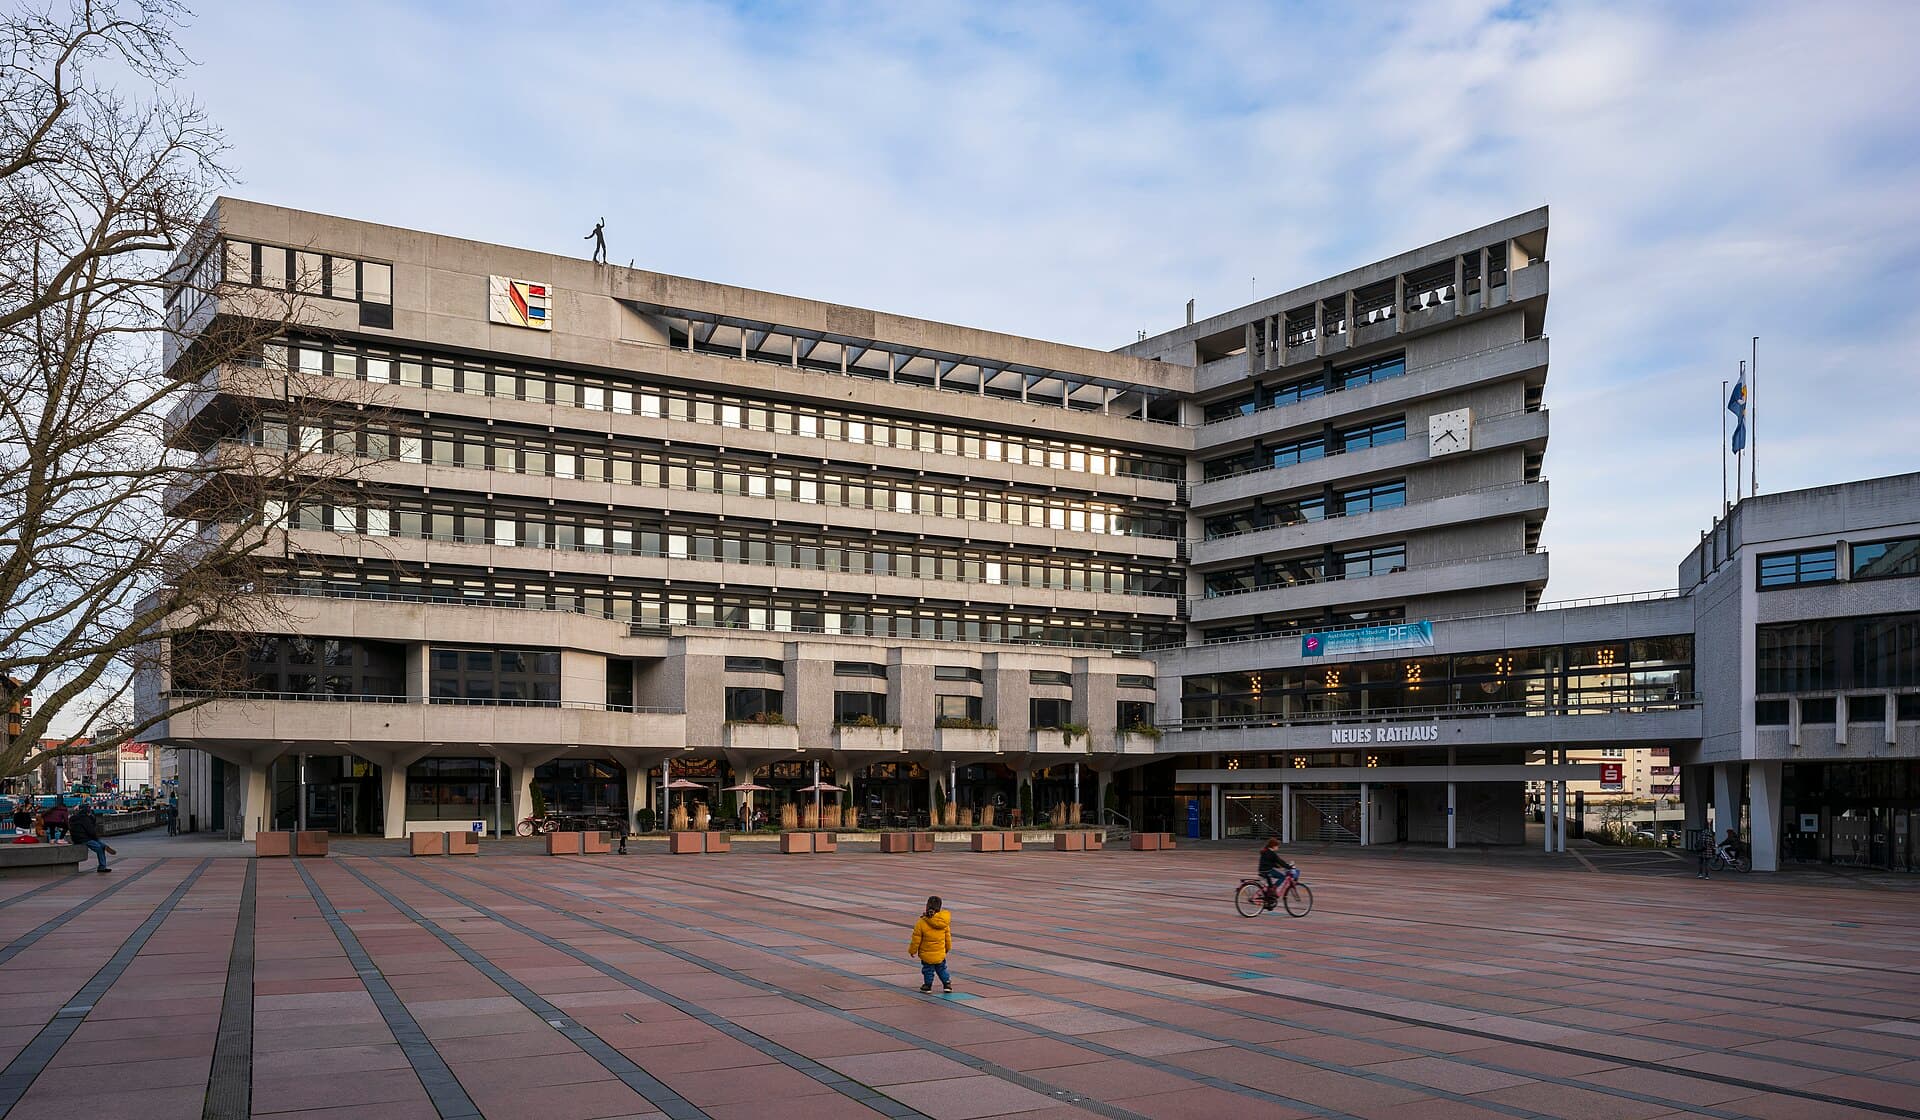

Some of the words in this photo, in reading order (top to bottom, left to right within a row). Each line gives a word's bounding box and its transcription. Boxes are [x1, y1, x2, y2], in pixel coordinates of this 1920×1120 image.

[1388, 626, 1407, 641] PF
[1331, 728, 1372, 743] NEUES
[1376, 725, 1438, 742] RATHAUS
